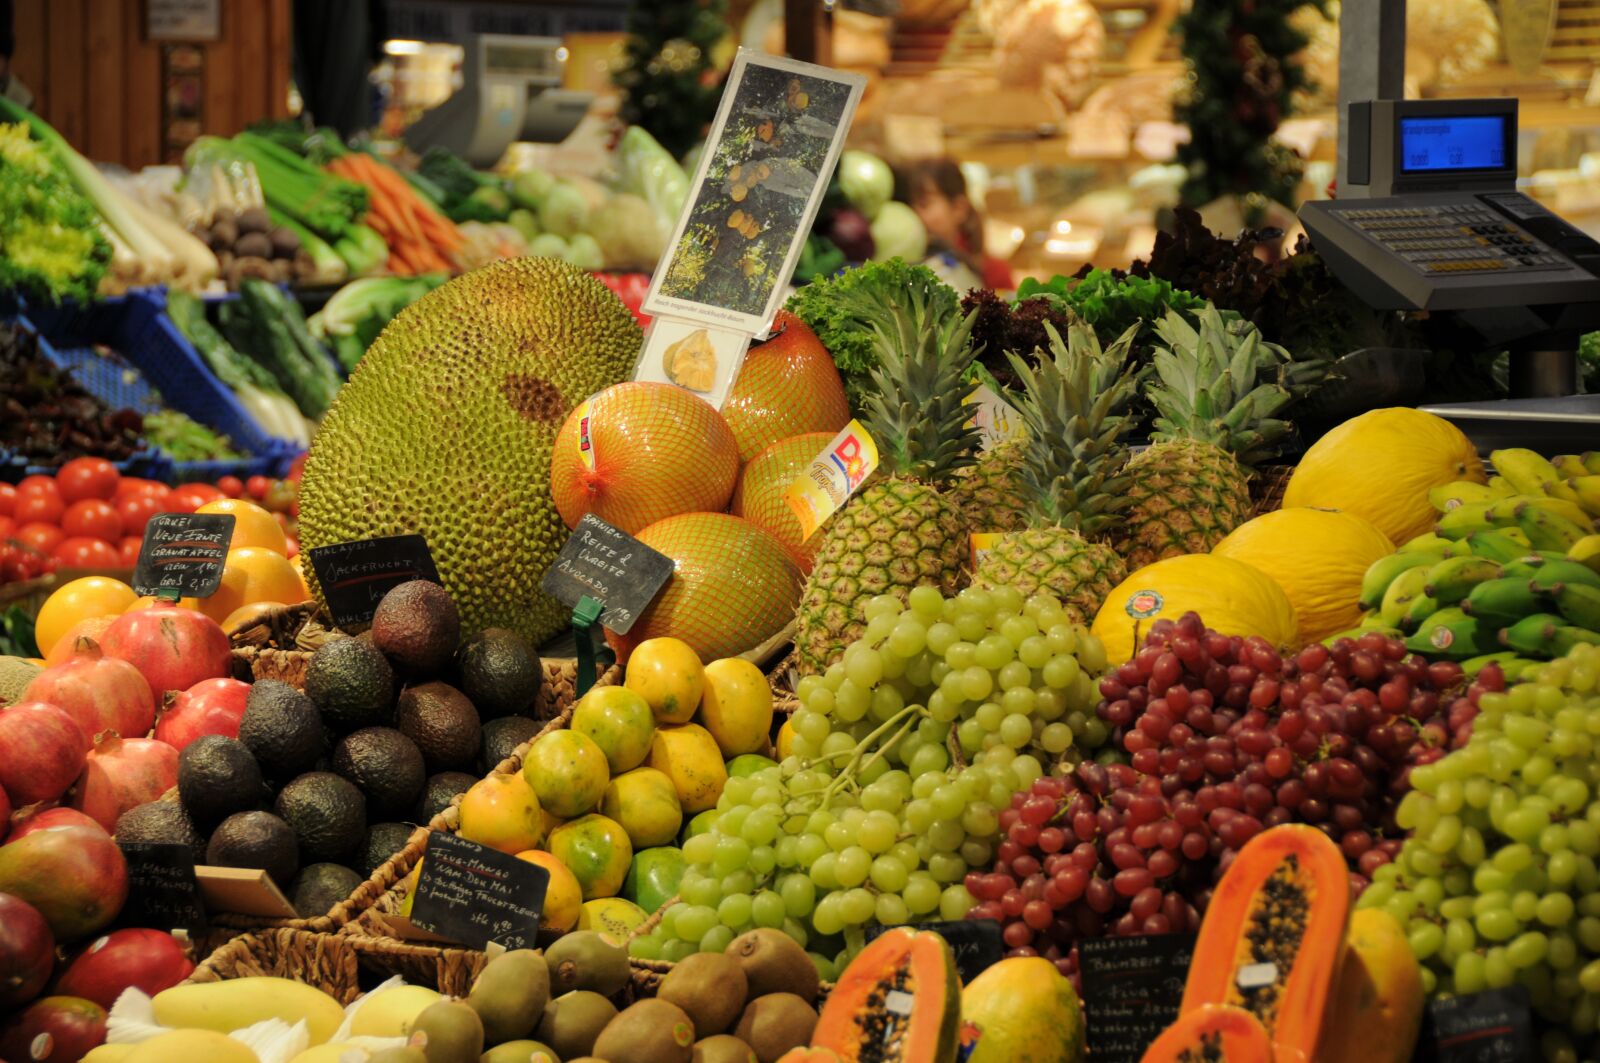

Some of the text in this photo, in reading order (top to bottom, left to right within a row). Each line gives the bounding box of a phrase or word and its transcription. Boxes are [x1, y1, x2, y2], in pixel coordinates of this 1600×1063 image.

[153, 530, 182, 541] NEUE
[583, 513, 623, 540] SPANIEN
[580, 530, 618, 558] REIFE
[558, 559, 609, 594] AVOCADO
[430, 848, 509, 878] FLUG-MANGO
